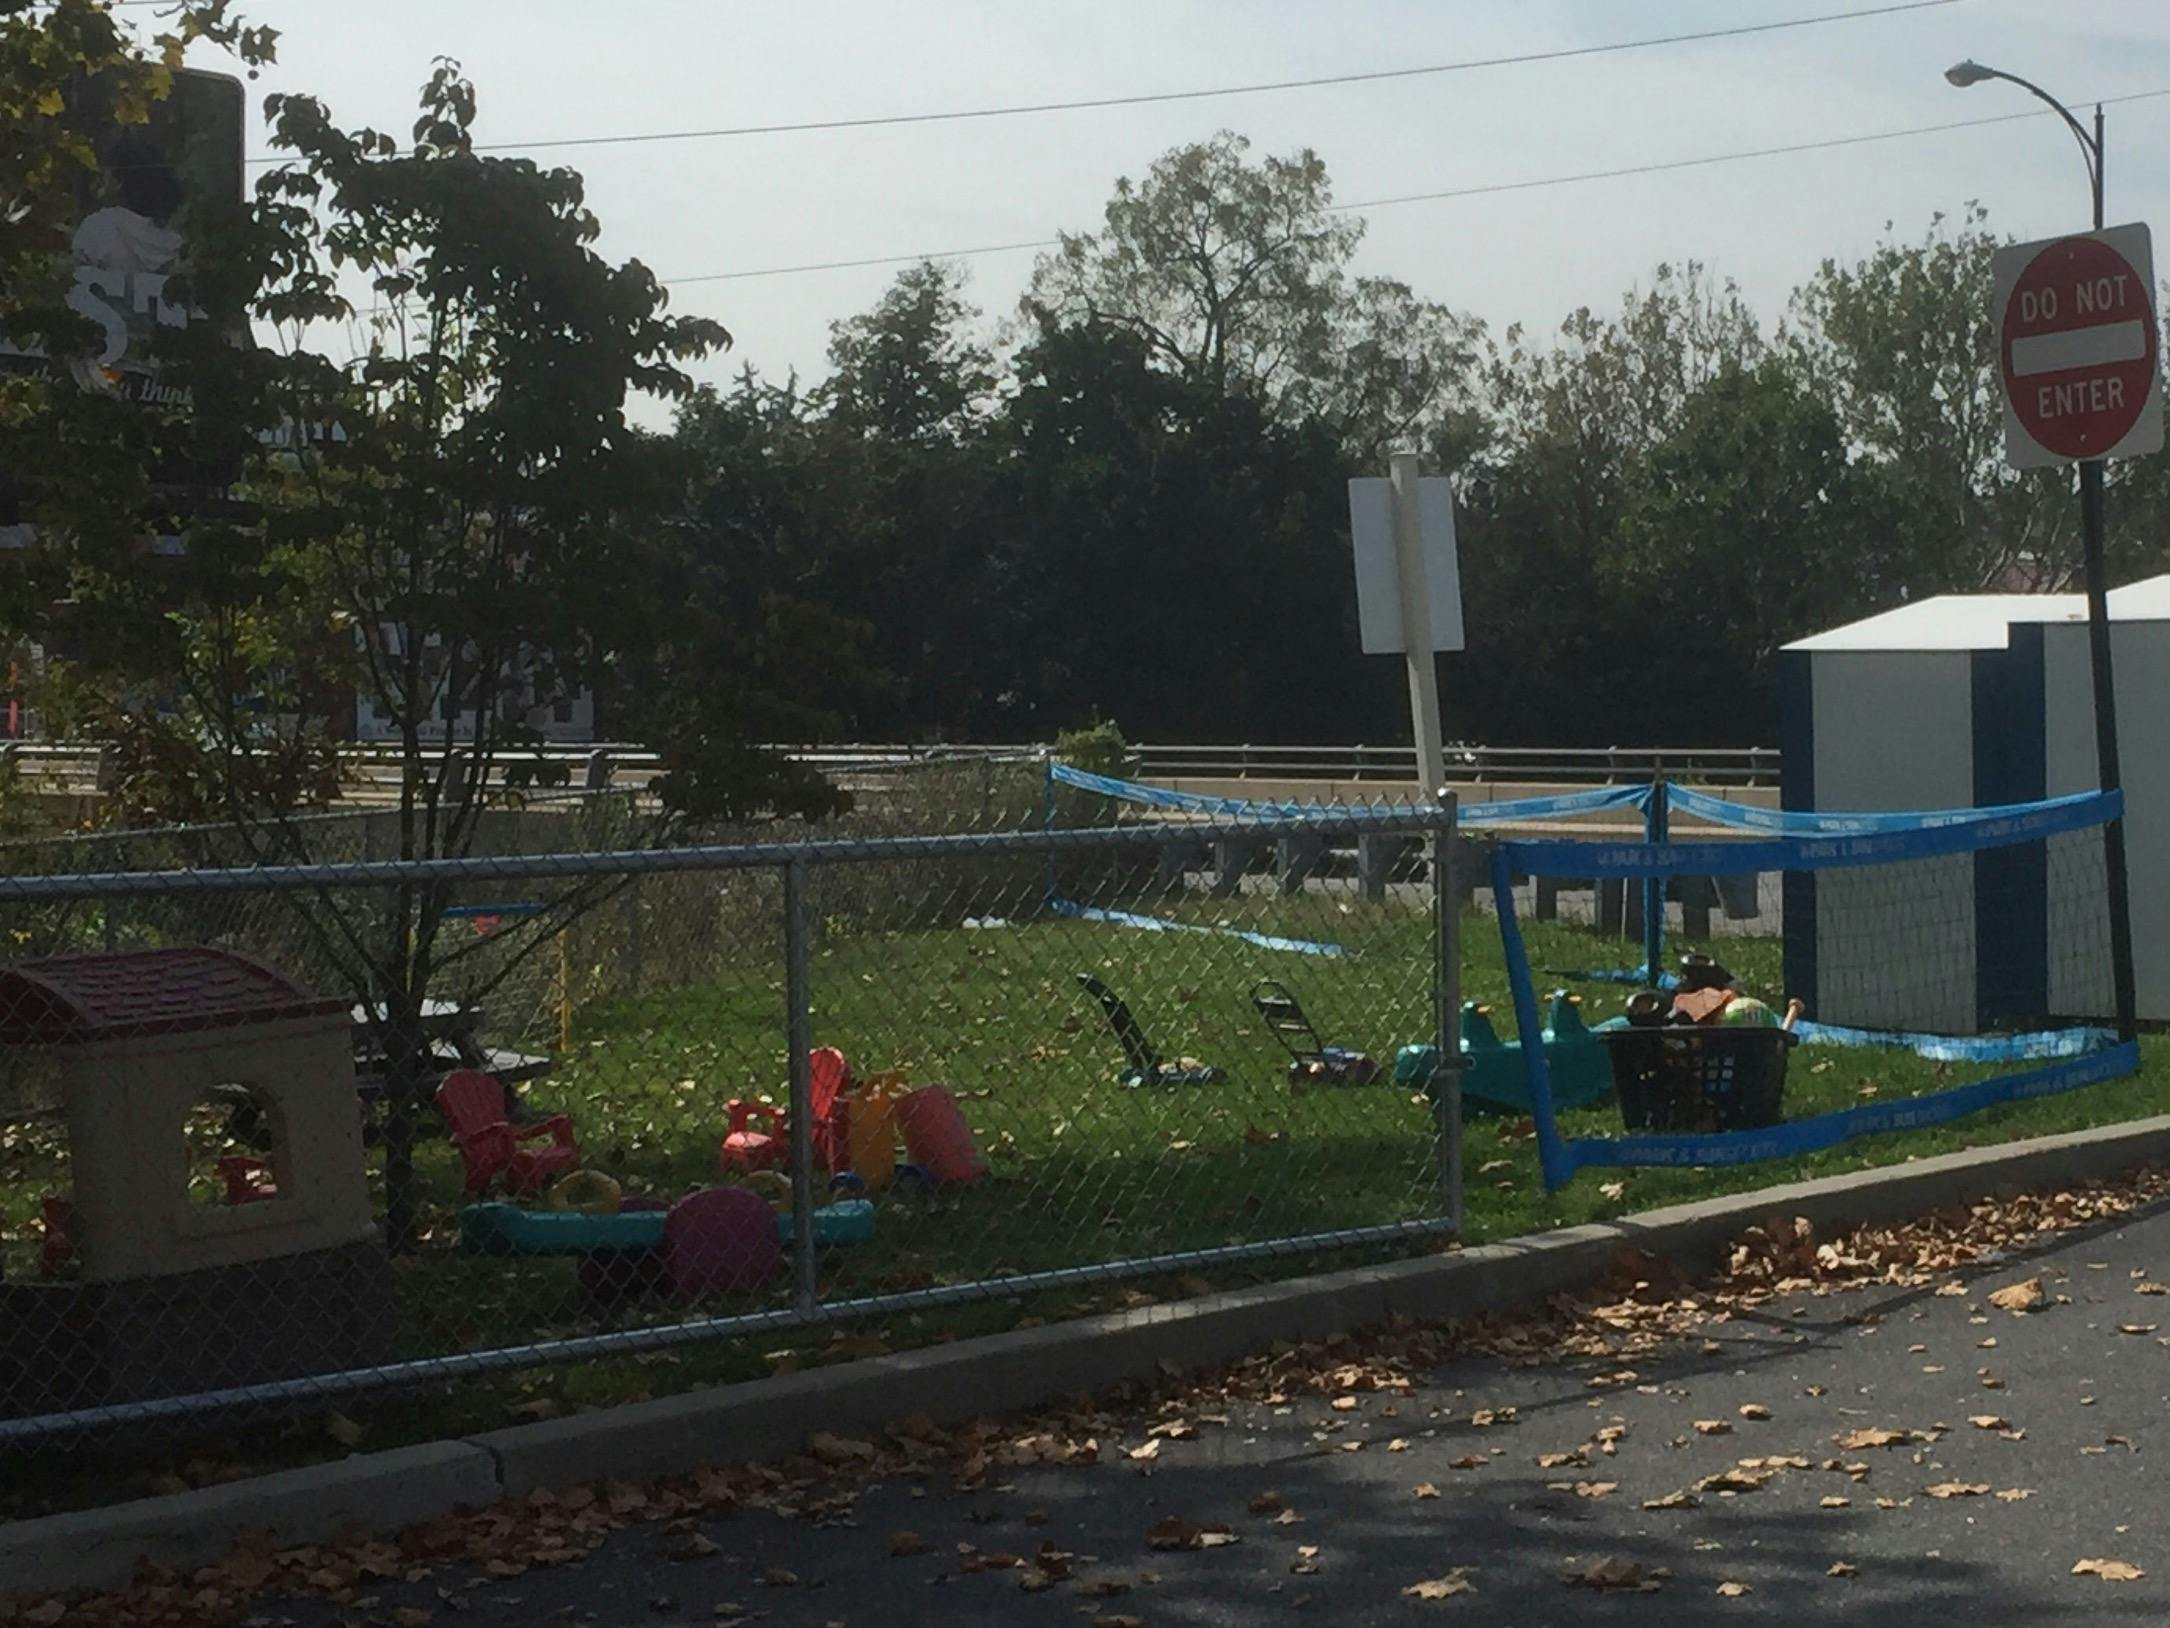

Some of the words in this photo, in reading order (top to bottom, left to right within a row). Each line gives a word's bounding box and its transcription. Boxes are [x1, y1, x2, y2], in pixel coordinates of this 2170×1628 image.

[2020, 287, 2058, 323] DO
[2076, 275, 2128, 315] NOT
[2038, 377, 2125, 419] ENTER
